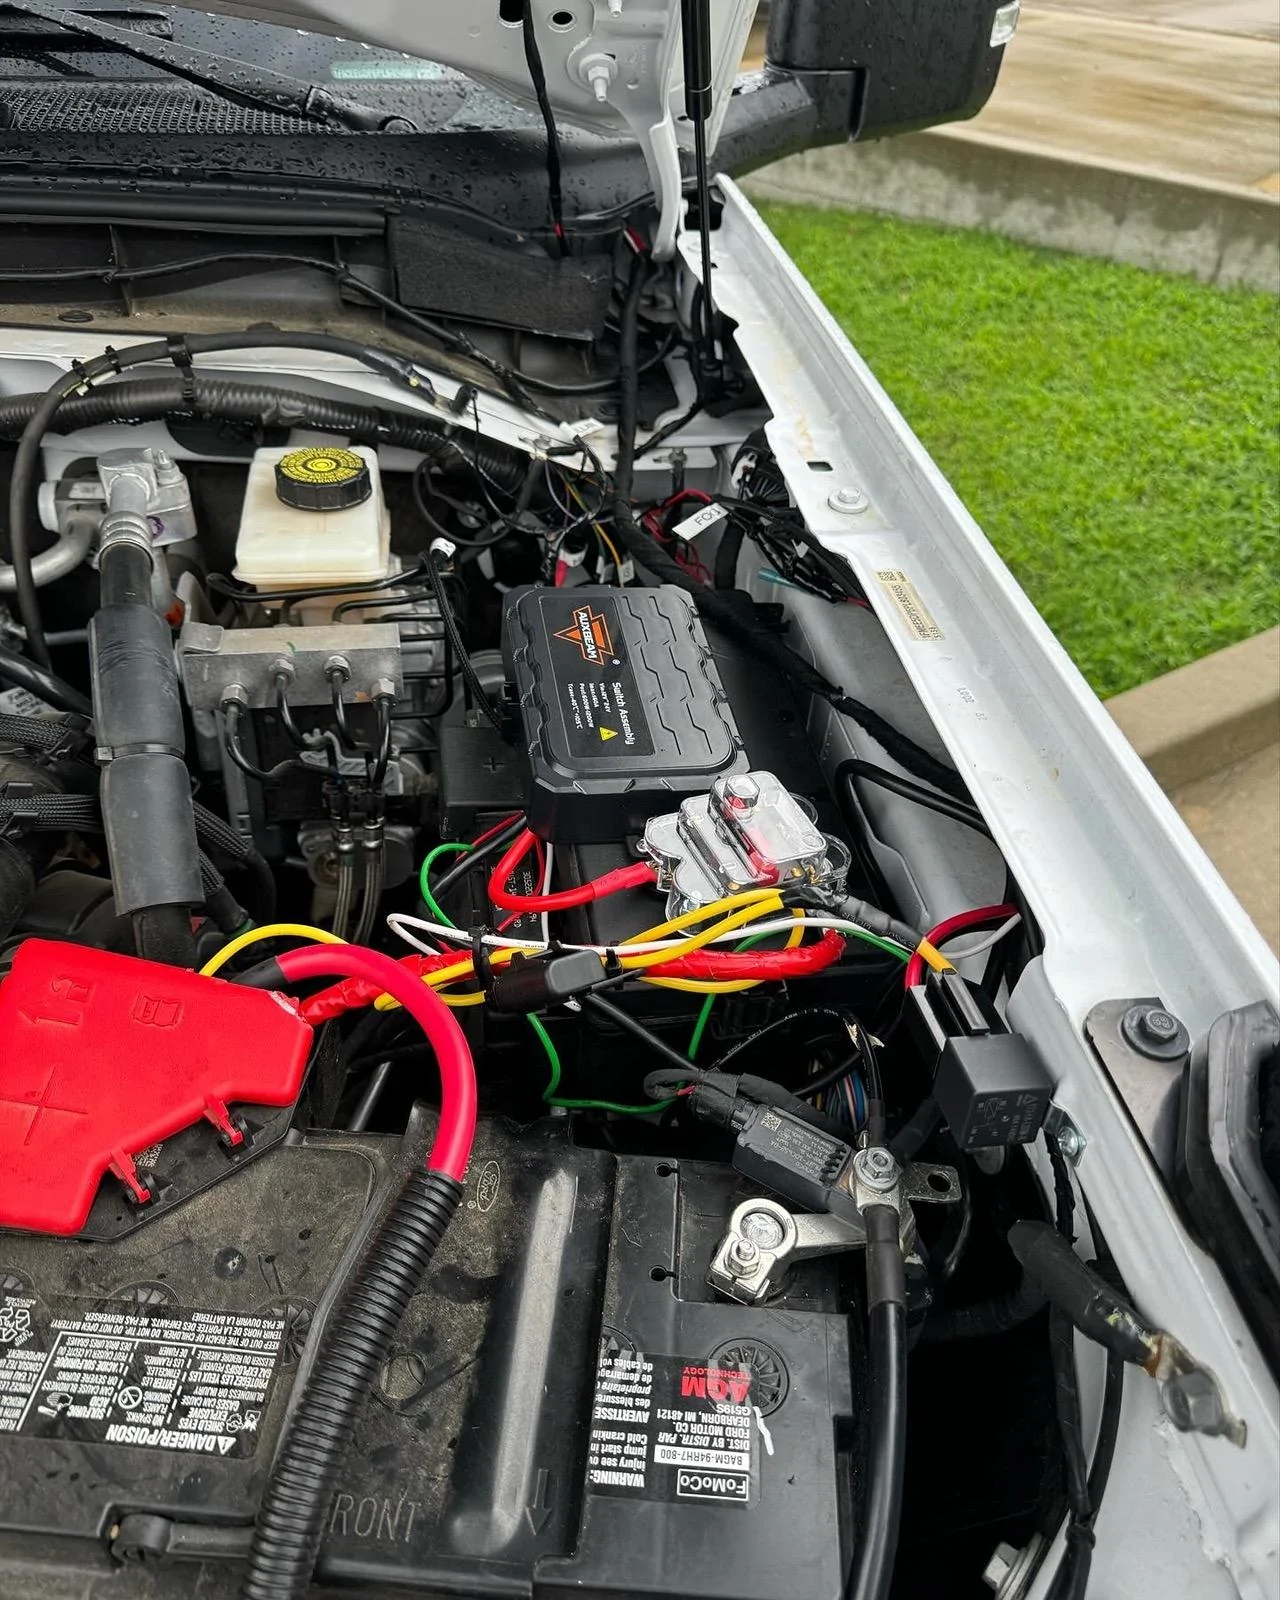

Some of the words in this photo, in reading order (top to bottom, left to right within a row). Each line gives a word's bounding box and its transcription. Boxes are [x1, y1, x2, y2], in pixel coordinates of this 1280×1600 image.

[578, 610, 597, 659] AUXBEAM
[612, 682, 625, 706] Switch
[618, 708, 635, 744] Assembly
[124, 1315, 139, 1325] PAS
[138, 1317, 149, 1326] NE
[226, 1316, 235, 1325] LA
[234, 1316, 261, 1327] OUVRIR
[261, 1319, 275, 1329] PAS
[274, 1320, 284, 1329] NE
[81, 1322, 98, 1332] OPEN
[97, 1323, 112, 1333] NOT
[112, 1324, 123, 1334] DO
[136, 1327, 150, 1336] NOT
[182, 1321, 196, 1331] DES
[223, 1326, 232, 1334] LA
[232, 1326, 242, 1335] DE
[150, 1328, 161, 1337] DO
[162, 1329, 195, 1341] CHILDREN.
[194, 1332, 204, 1342] OF
[242, 1327, 262, 1338] HORS
[262, 1330, 281, 1339] TENIR
[204, 1334, 227, 1344] REACH
[226, 1336, 239, 1346] THE
[239, 1338, 250, 1347] OF
[250, 1339, 263, 1348] OUT
[263, 1340, 279, 1349] KEEP
[177, 1348, 188, 1357] DE
[642, 1361, 652, 1372] de
[56, 1370, 81, 1382] BURNS
[80, 1372, 107, 1384] SEVERE
[188, 1370, 202, 1382] LES
[641, 1373, 652, 1383] de
[682, 1366, 751, 1379] TECHNOLOGY
[107, 1375, 118, 1385] OR
[140, 1376, 154, 1387] LES
[220, 1373, 234, 1385] LES
[233, 1375, 268, 1389] PROTÉGEZ
[77, 1383, 99, 1394] CAUSE
[99, 1385, 114, 1396] CAN
[217, 1387, 228, 1397] OR
[682, 1376, 750, 1402] AGM
[180, 1394, 202, 1406] CAUSE
[228, 1388, 264, 1401] BLINDNESS
[89, 1395, 110, 1408] ACID
[202, 1397, 216, 1407] CAN
[215, 1398, 239, 1411] GASES
[634, 1397, 650, 1408] des
[66, 1403, 106, 1419] SULFURIC
[187, 1407, 228, 1421] EXPLOSIVE
[594, 1406, 649, 1423] AVERTISSE
[656, 1408, 683, 1420] 48121
[715, 1403, 751, 1415] G519S
[151, 1414, 164, 1426] NO
[684, 1411, 696, 1421] MI
[698, 1411, 750, 1427] DEARBORN,
[177, 1417, 198, 1430] EYES
[197, 1419, 224, 1432] SHIELD
[672, 1421, 688, 1432] CO.
[690, 1423, 723, 1436] MOTOR
[725, 1426, 750, 1439] FORD
[105, 1424, 216, 1451] DANGER/POISON
[626, 1432, 647, 1444] Cold
[657, 1431, 677, 1443] PAR
[679, 1434, 709, 1446] DISTR.
[712, 1437, 724, 1448] BY
[590, 1442, 599, 1453] in
[600, 1443, 622, 1454] start
[727, 1438, 750, 1450] DIST.
[623, 1443, 646, 1458] jump
[600, 1456, 617, 1466] see
[660, 1449, 742, 1466] BAGM-94RH7-800
[618, 1456, 645, 1471] injury
[589, 1469, 644, 1487] WARNING:
[680, 1475, 746, 1494] FoMoCo
